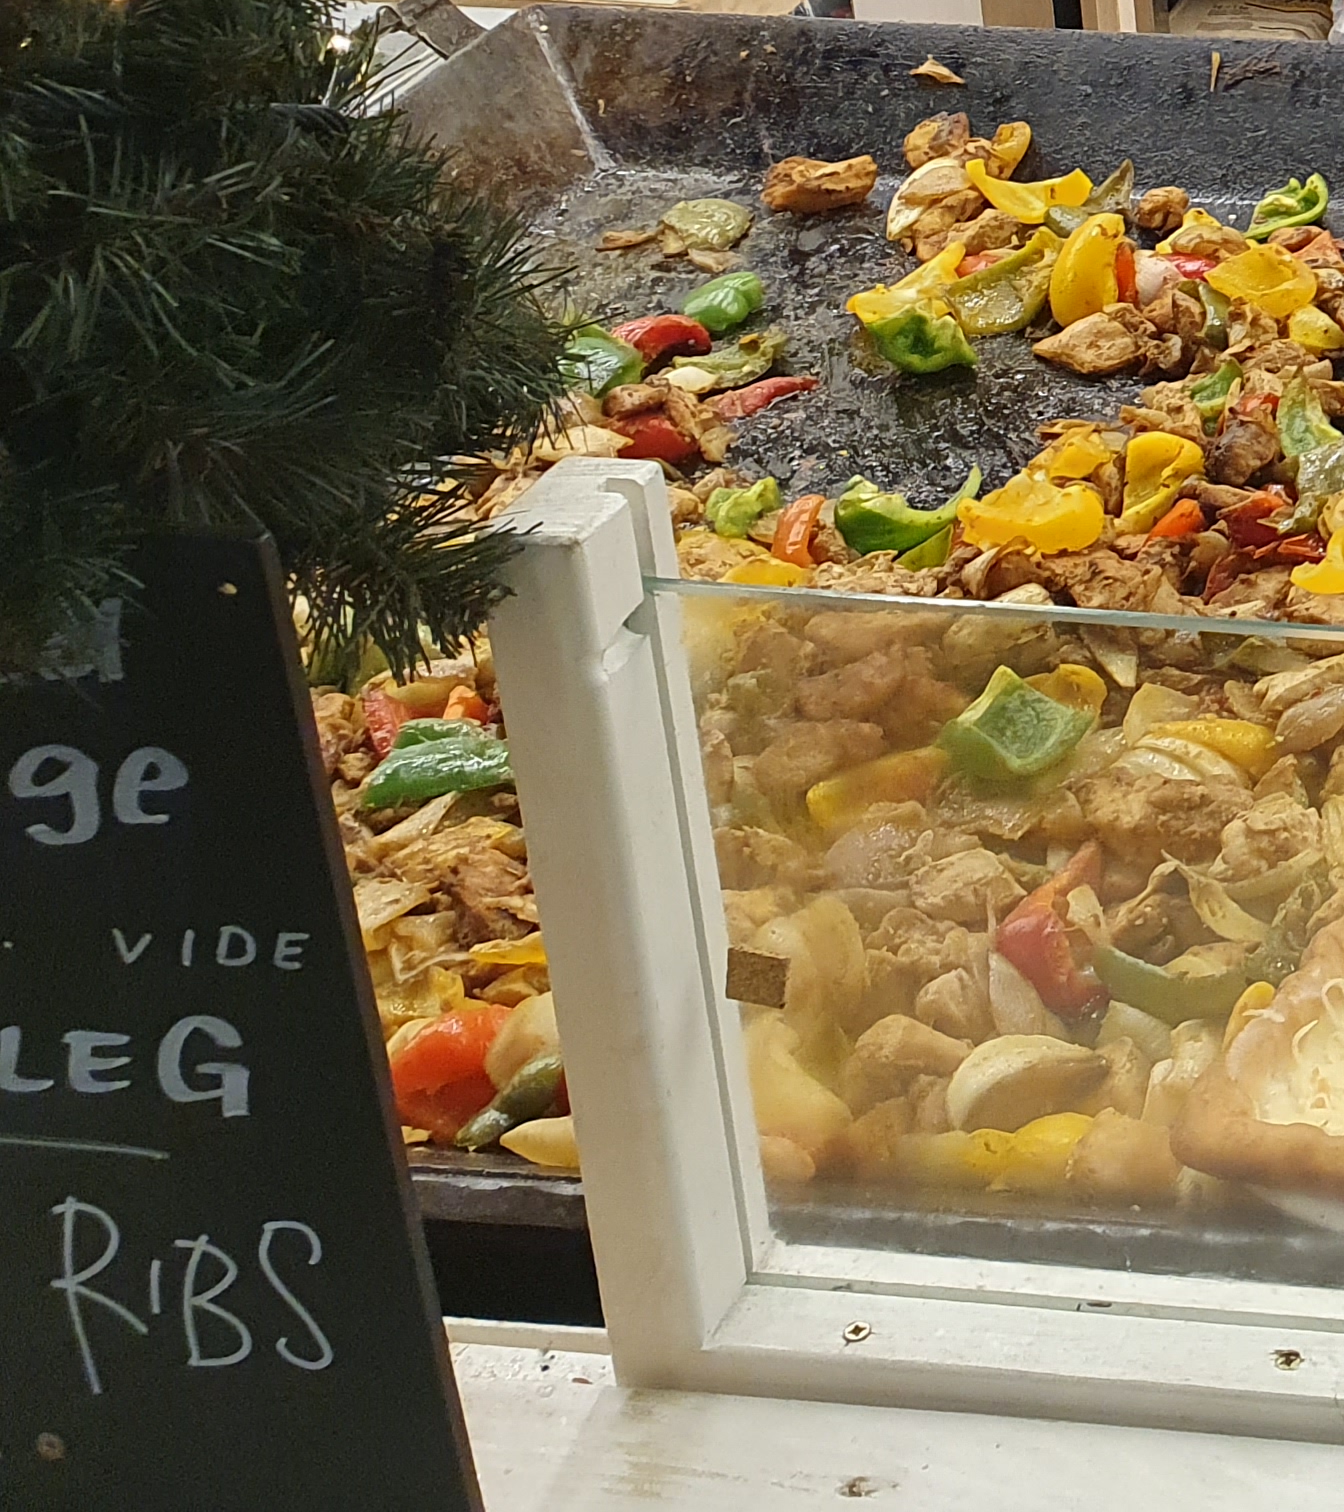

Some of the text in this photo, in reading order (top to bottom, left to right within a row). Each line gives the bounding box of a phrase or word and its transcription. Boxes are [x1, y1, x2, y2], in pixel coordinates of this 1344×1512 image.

[111, 925, 311, 970] VIDE
[0, 1015, 250, 1118] LEG
[50, 1195, 334, 1395] RIBS
